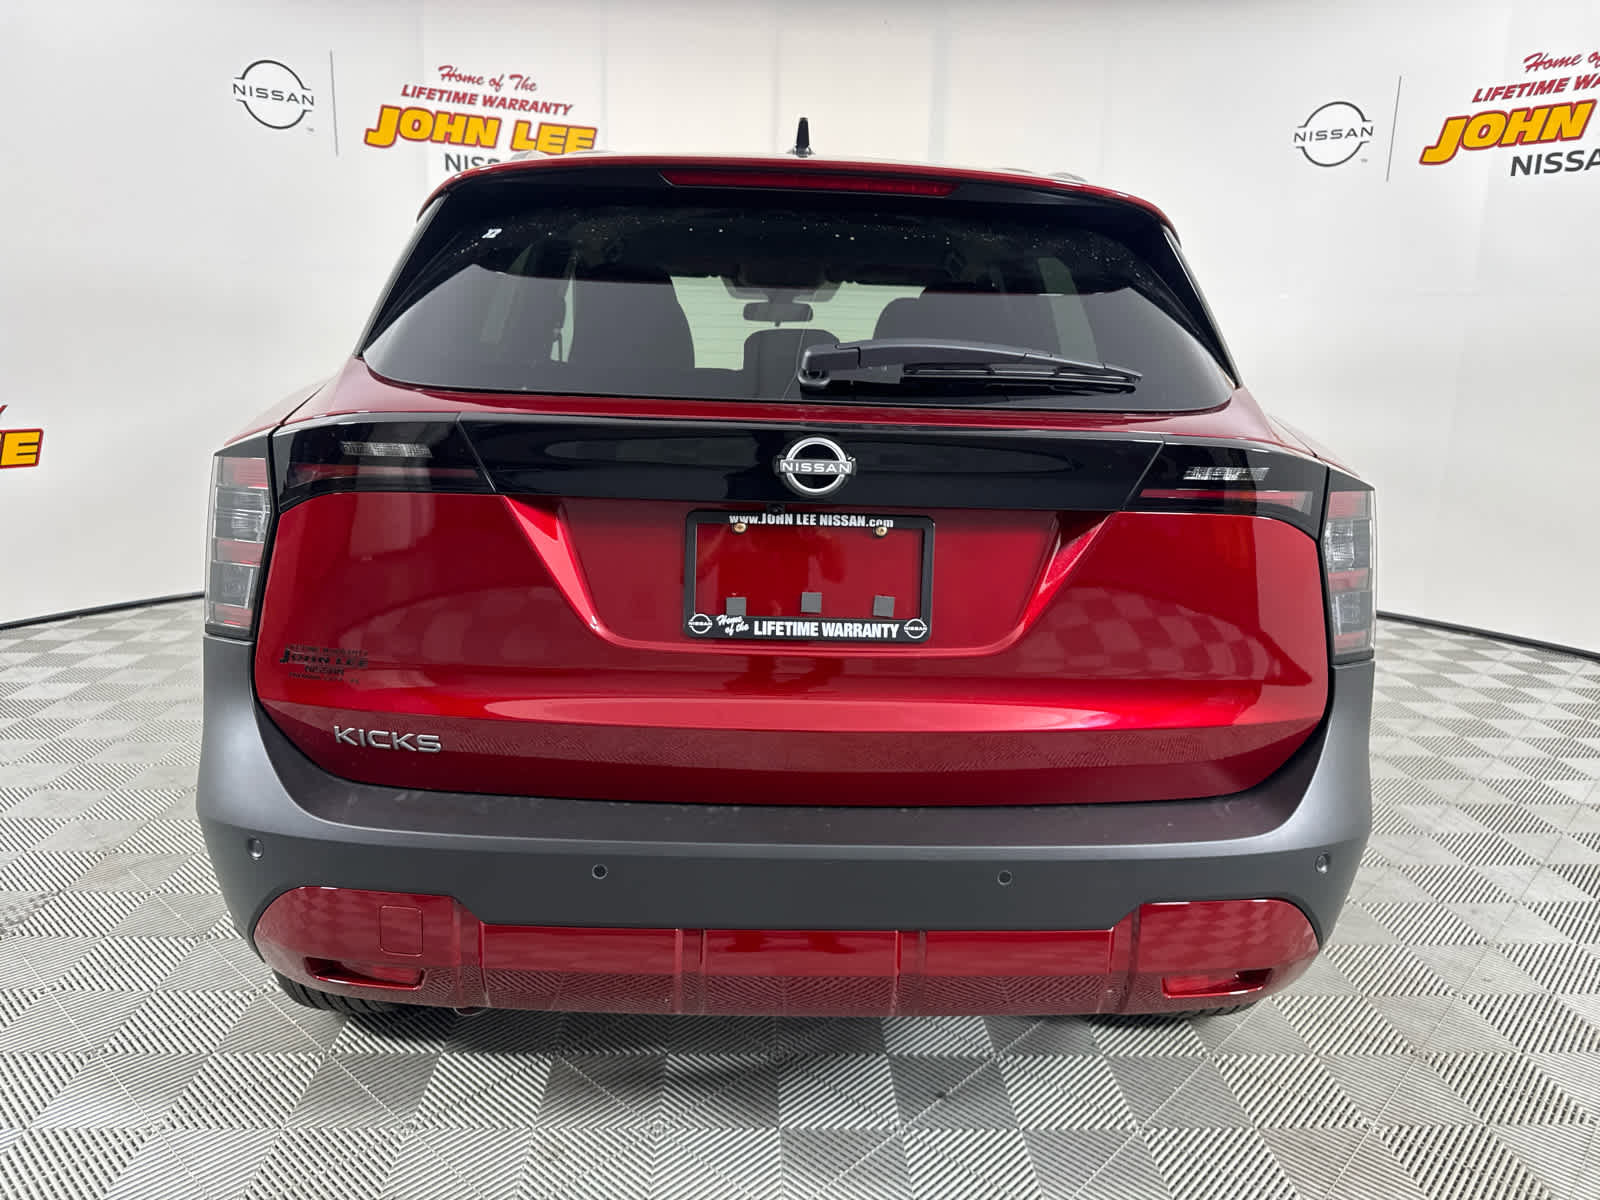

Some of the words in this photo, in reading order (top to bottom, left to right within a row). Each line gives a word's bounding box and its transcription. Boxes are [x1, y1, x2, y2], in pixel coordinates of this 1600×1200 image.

[1523, 51, 1584, 73] Home
[438, 65, 485, 86] Home
[488, 74, 505, 92] of
[508, 74, 538, 92] The
[1472, 76, 1571, 103] LIFETIME
[232, 83, 315, 106] NISSAN
[401, 84, 479, 105] LIFETIME
[481, 94, 573, 116] WARRANTY
[364, 104, 502, 149] JOHN
[510, 120, 598, 155] LEE
[1294, 125, 1375, 144] NISSAN
[1418, 98, 1598, 165] JOHN
[781, 461, 852, 474] NISSAN
[729, 513, 793, 525] www.JOHN
[796, 514, 817, 526] LEE
[819, 514, 894, 528] NISSAN.com
[716, 614, 743, 626] Home
[724, 624, 735, 637] of
[735, 621, 750, 633] the
[753, 620, 819, 637] LIFETIME
[821, 622, 900, 639] WARRANTY
[333, 725, 442, 753] KICKS
